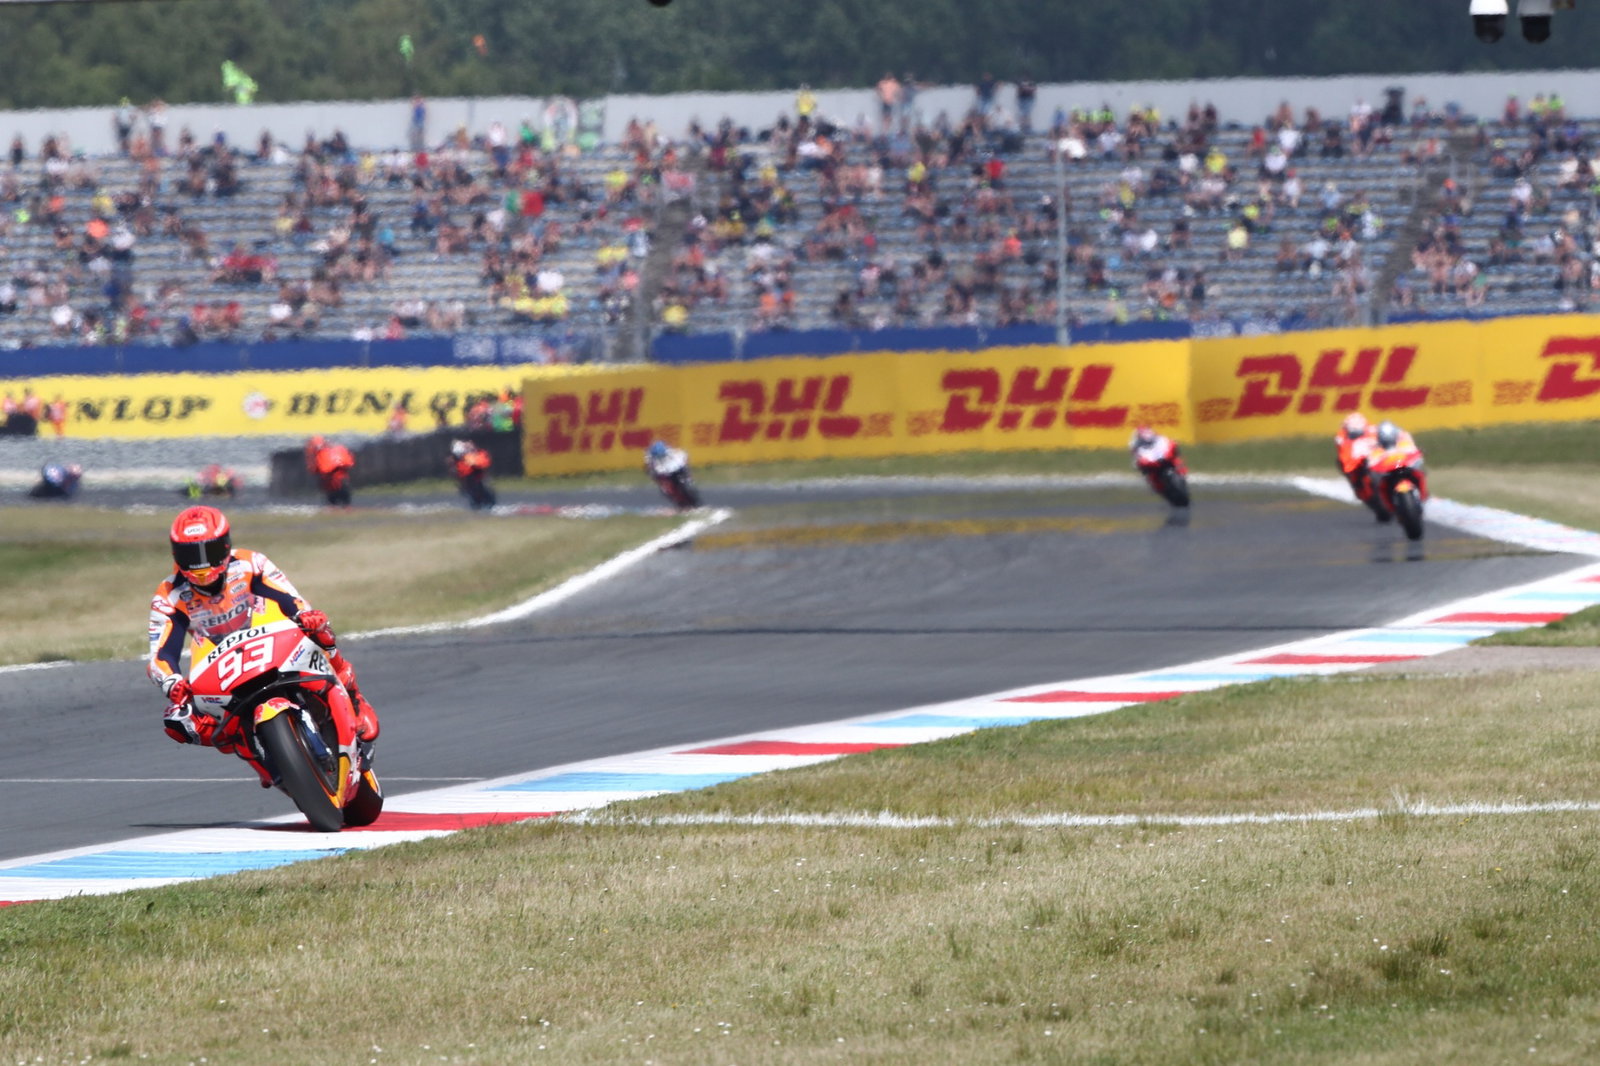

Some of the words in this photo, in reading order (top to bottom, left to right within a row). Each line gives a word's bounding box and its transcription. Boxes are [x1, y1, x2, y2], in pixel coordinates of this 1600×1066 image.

[41, 396, 214, 422] NLOP
[717, 375, 863, 443] DHL
[938, 364, 1128, 432] DHL
[1232, 345, 1432, 419] DHL
[542, 386, 654, 453] DHL
[207, 626, 269, 664] REPSOL
[217, 635, 275, 692] 93
